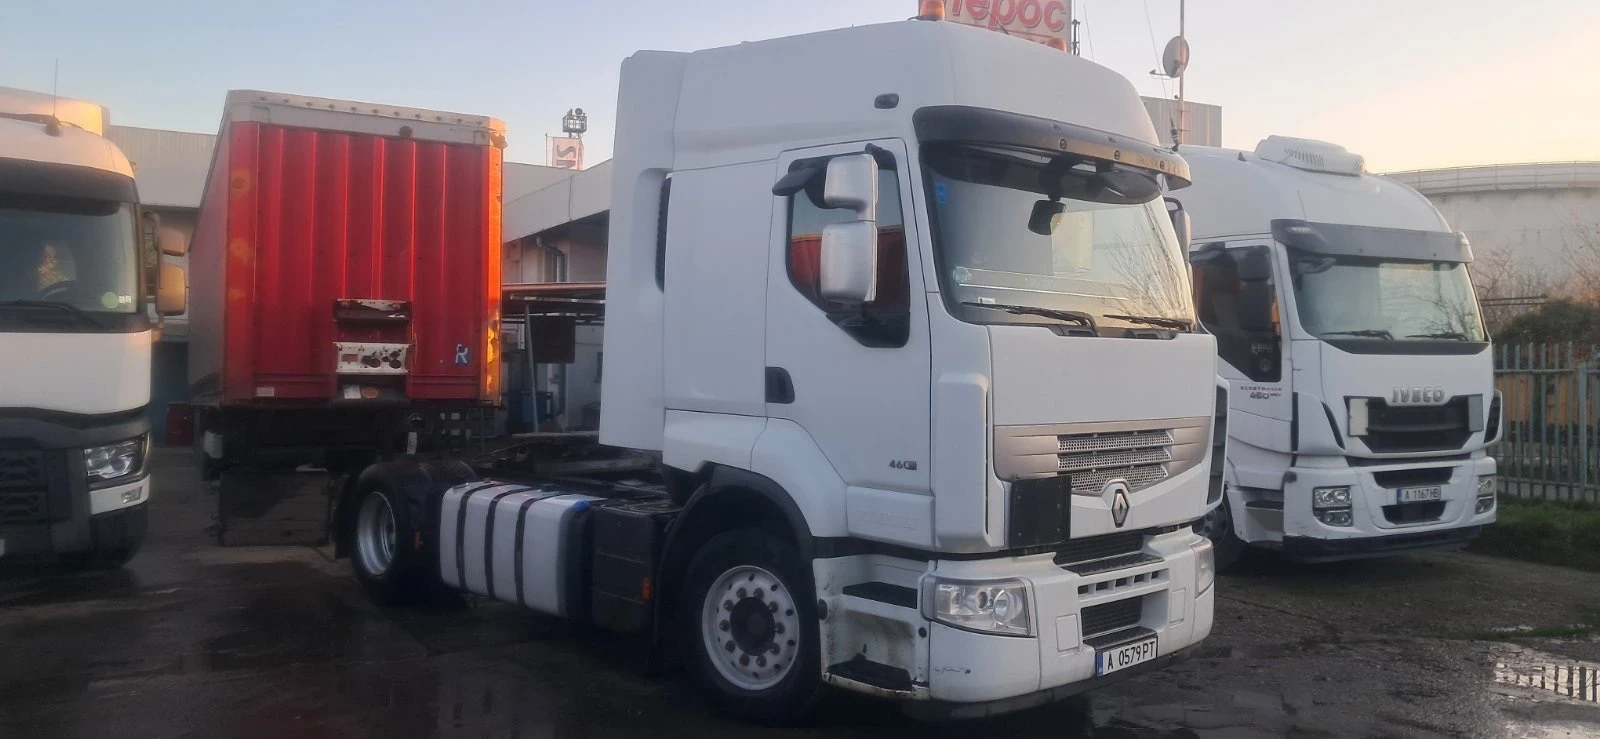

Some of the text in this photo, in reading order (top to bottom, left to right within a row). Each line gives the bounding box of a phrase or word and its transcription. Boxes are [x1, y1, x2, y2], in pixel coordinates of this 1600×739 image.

[1250, 391, 1270, 400] 460
[1391, 386, 1445, 403] IVECO
[1107, 653, 1114, 670] A
